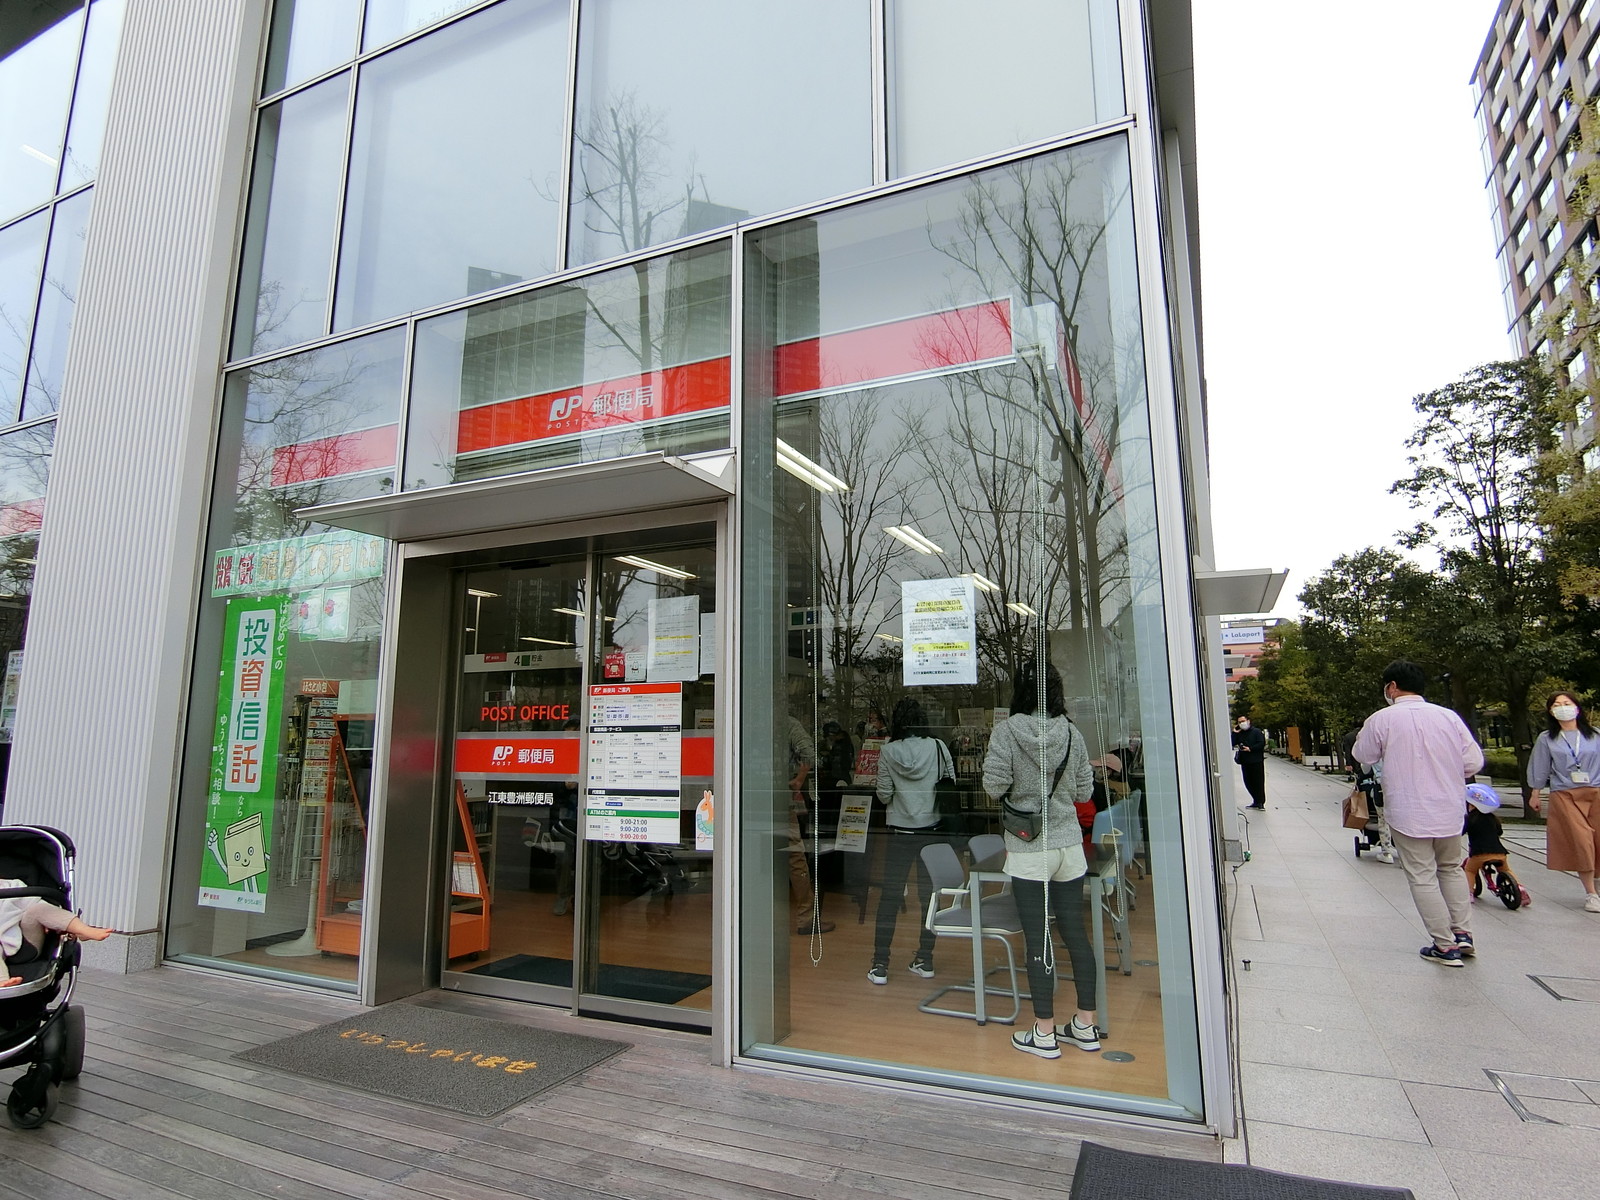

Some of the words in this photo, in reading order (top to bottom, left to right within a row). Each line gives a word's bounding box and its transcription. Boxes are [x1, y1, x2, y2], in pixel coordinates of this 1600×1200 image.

[592, 385, 654, 417] 郵便局
[547, 419, 579, 430] POST
[274, 602, 289, 670] はじめての
[1231, 631, 1261, 639] LaLaport
[514, 655, 521, 666] 4
[231, 617, 270, 784] 投資信託
[481, 706, 517, 721] POST
[520, 705, 570, 720] OFFICE
[518, 748, 555, 764] 郵便局
[237, 795, 244, 818] なら
[488, 791, 554, 806] 江東豊洲郵便局
[338, 1029, 538, 1074] いらっしゃいませ
